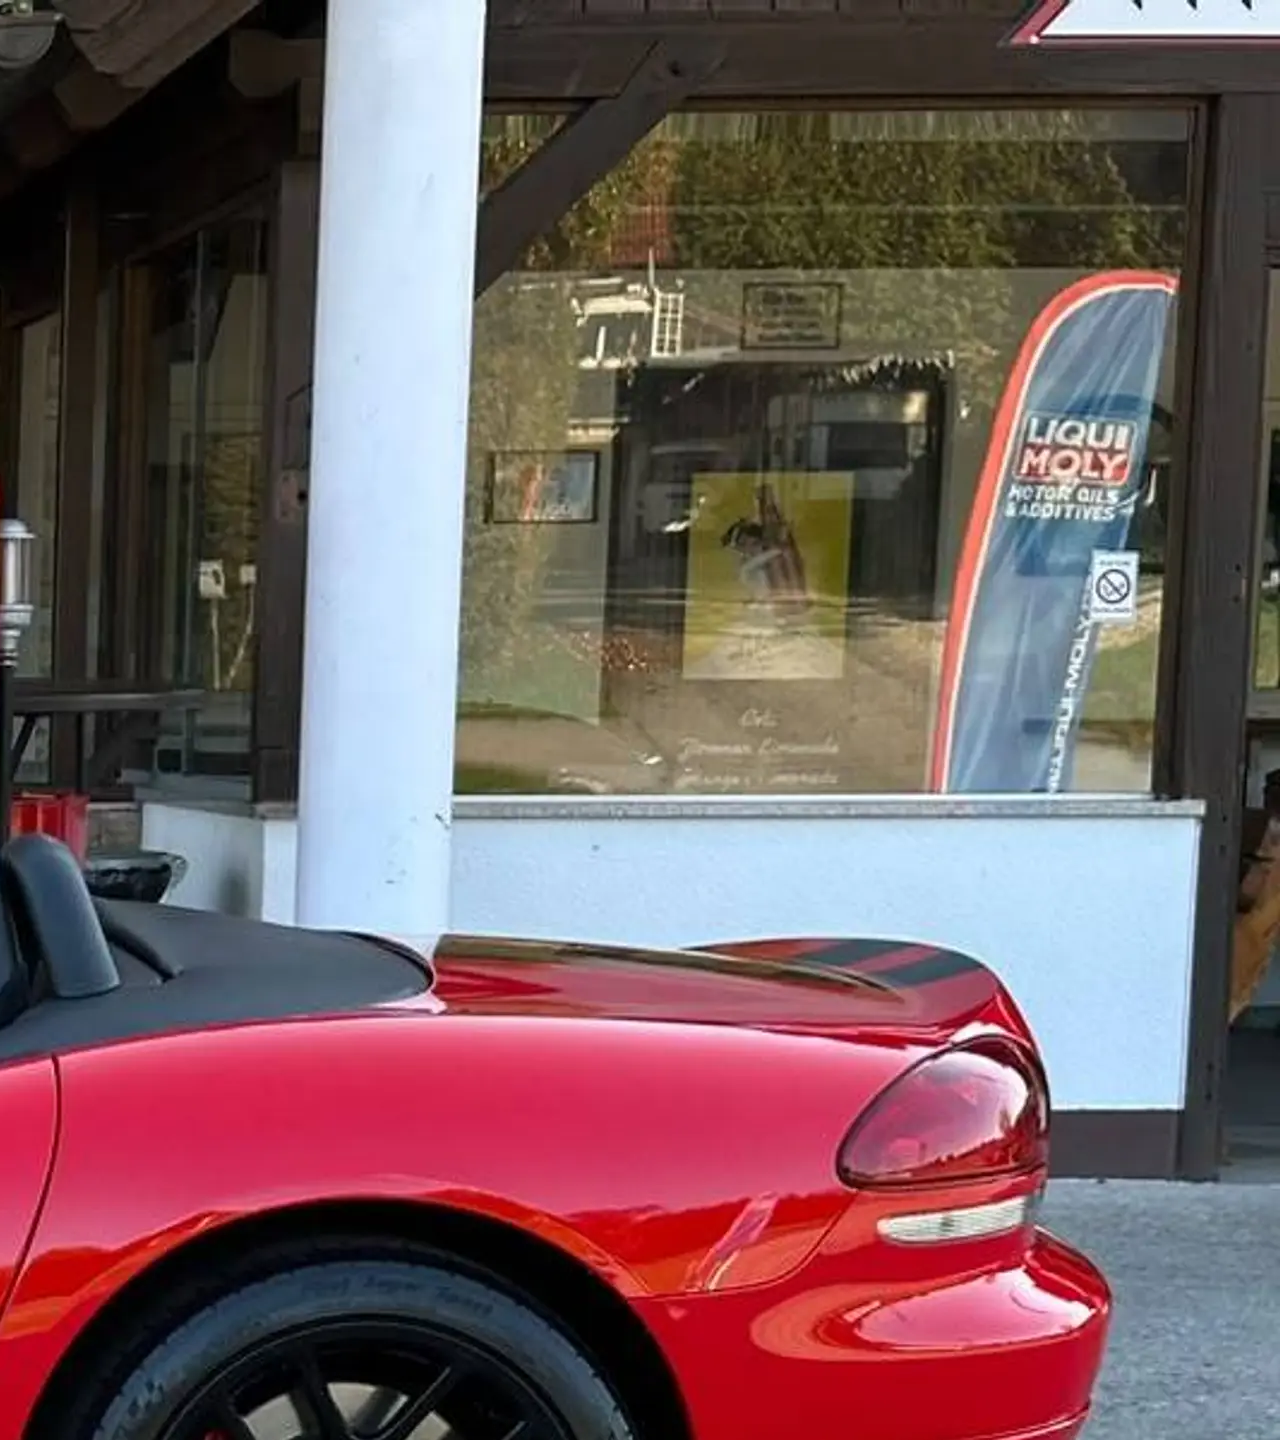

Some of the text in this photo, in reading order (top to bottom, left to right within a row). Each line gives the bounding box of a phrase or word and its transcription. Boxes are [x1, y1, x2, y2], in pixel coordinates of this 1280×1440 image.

[1027, 417, 1130, 449] LIQUI
[1020, 447, 1127, 479] MOLY
[1076, 486, 1120, 504] OILS
[1018, 502, 1117, 522] ADDITIVES
